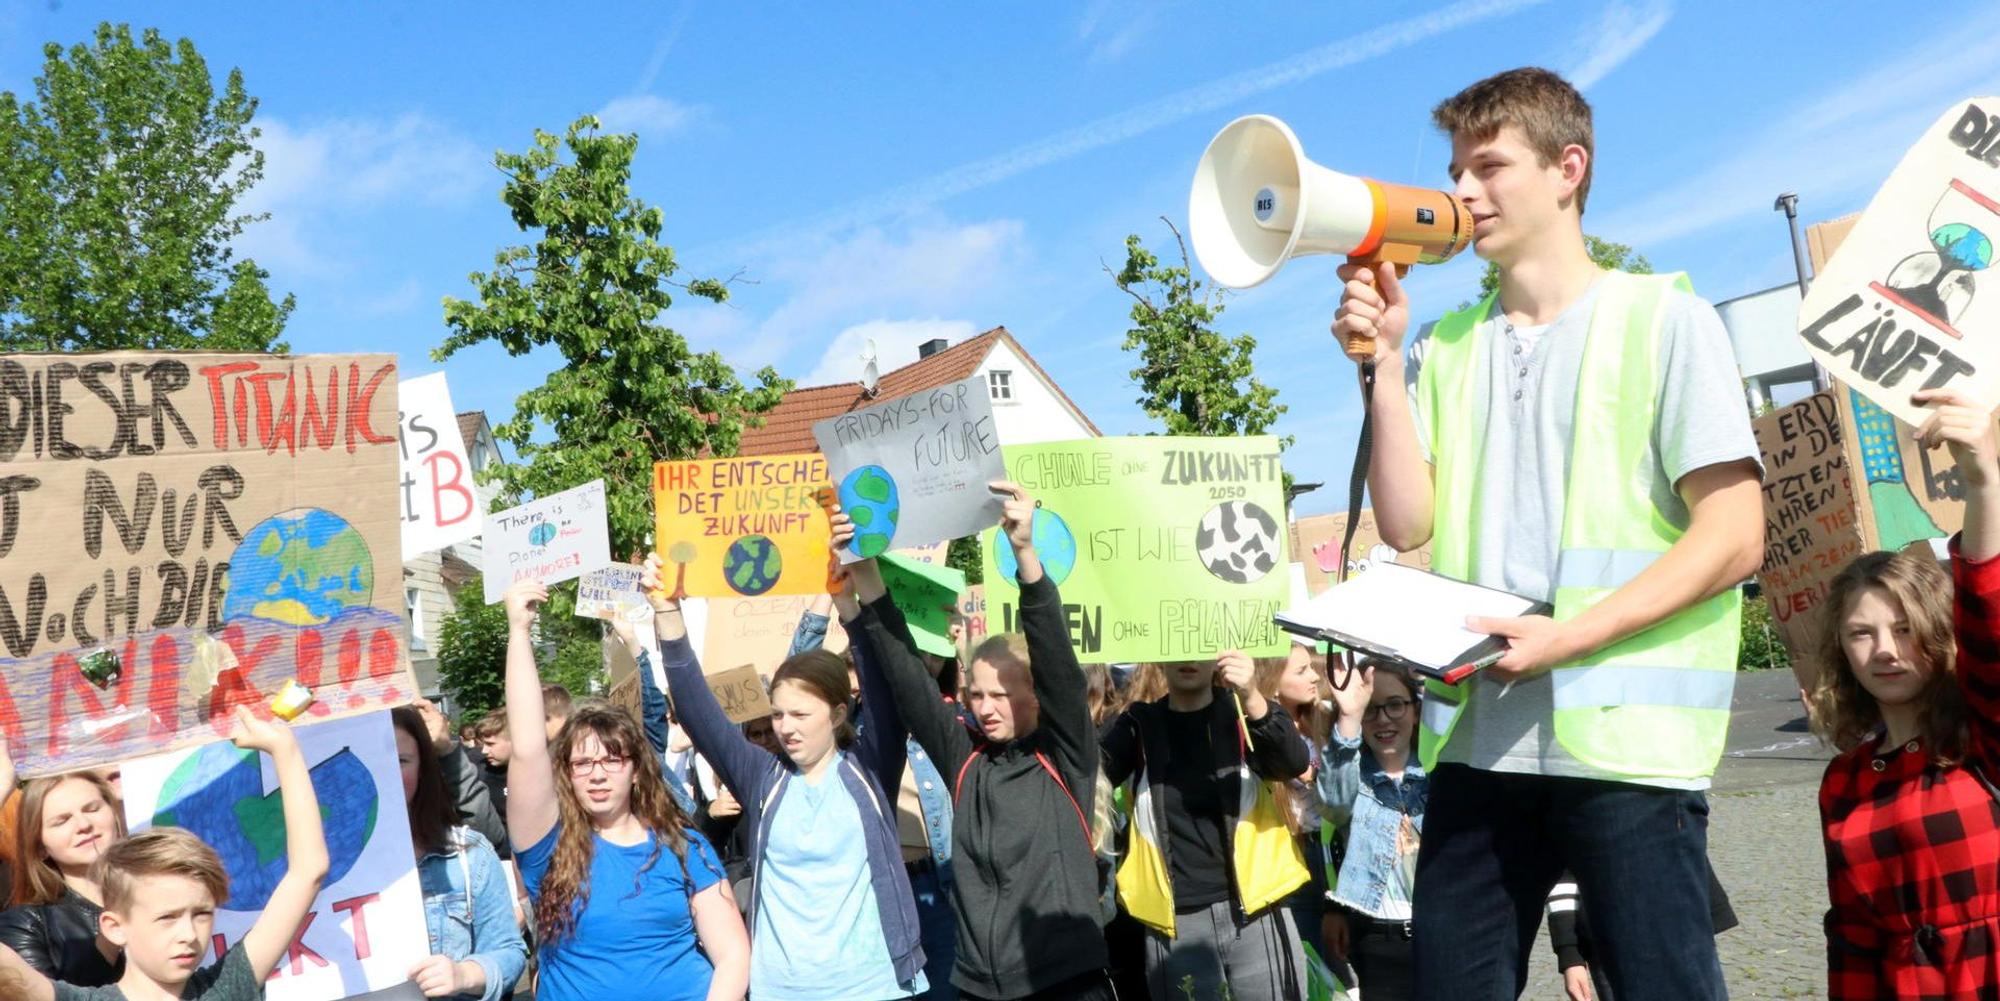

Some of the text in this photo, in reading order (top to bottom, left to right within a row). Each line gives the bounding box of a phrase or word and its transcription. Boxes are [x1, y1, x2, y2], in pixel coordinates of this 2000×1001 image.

[1800, 293, 1976, 391] LÄUFT
[0, 359, 199, 461] DIESER
[914, 415, 1000, 471] FUTURE
[1773, 445, 1796, 468] IN
[422, 449, 475, 527] B
[658, 464, 701, 491] IHR
[1006, 452, 1113, 489] CHULE
[1121, 462, 1149, 476] OHNE
[1160, 449, 1280, 486] ZUKUNFT
[83, 464, 244, 560] NUR
[678, 485, 833, 514] DET UNSERE
[1208, 486, 1247, 500] 2050
[497, 511, 544, 532] There
[704, 512, 811, 536] ZUKUNFT
[1089, 526, 1195, 563] IST WIE
[1113, 621, 1150, 640] OHNE
[1159, 599, 1281, 656] PFLANZEN
